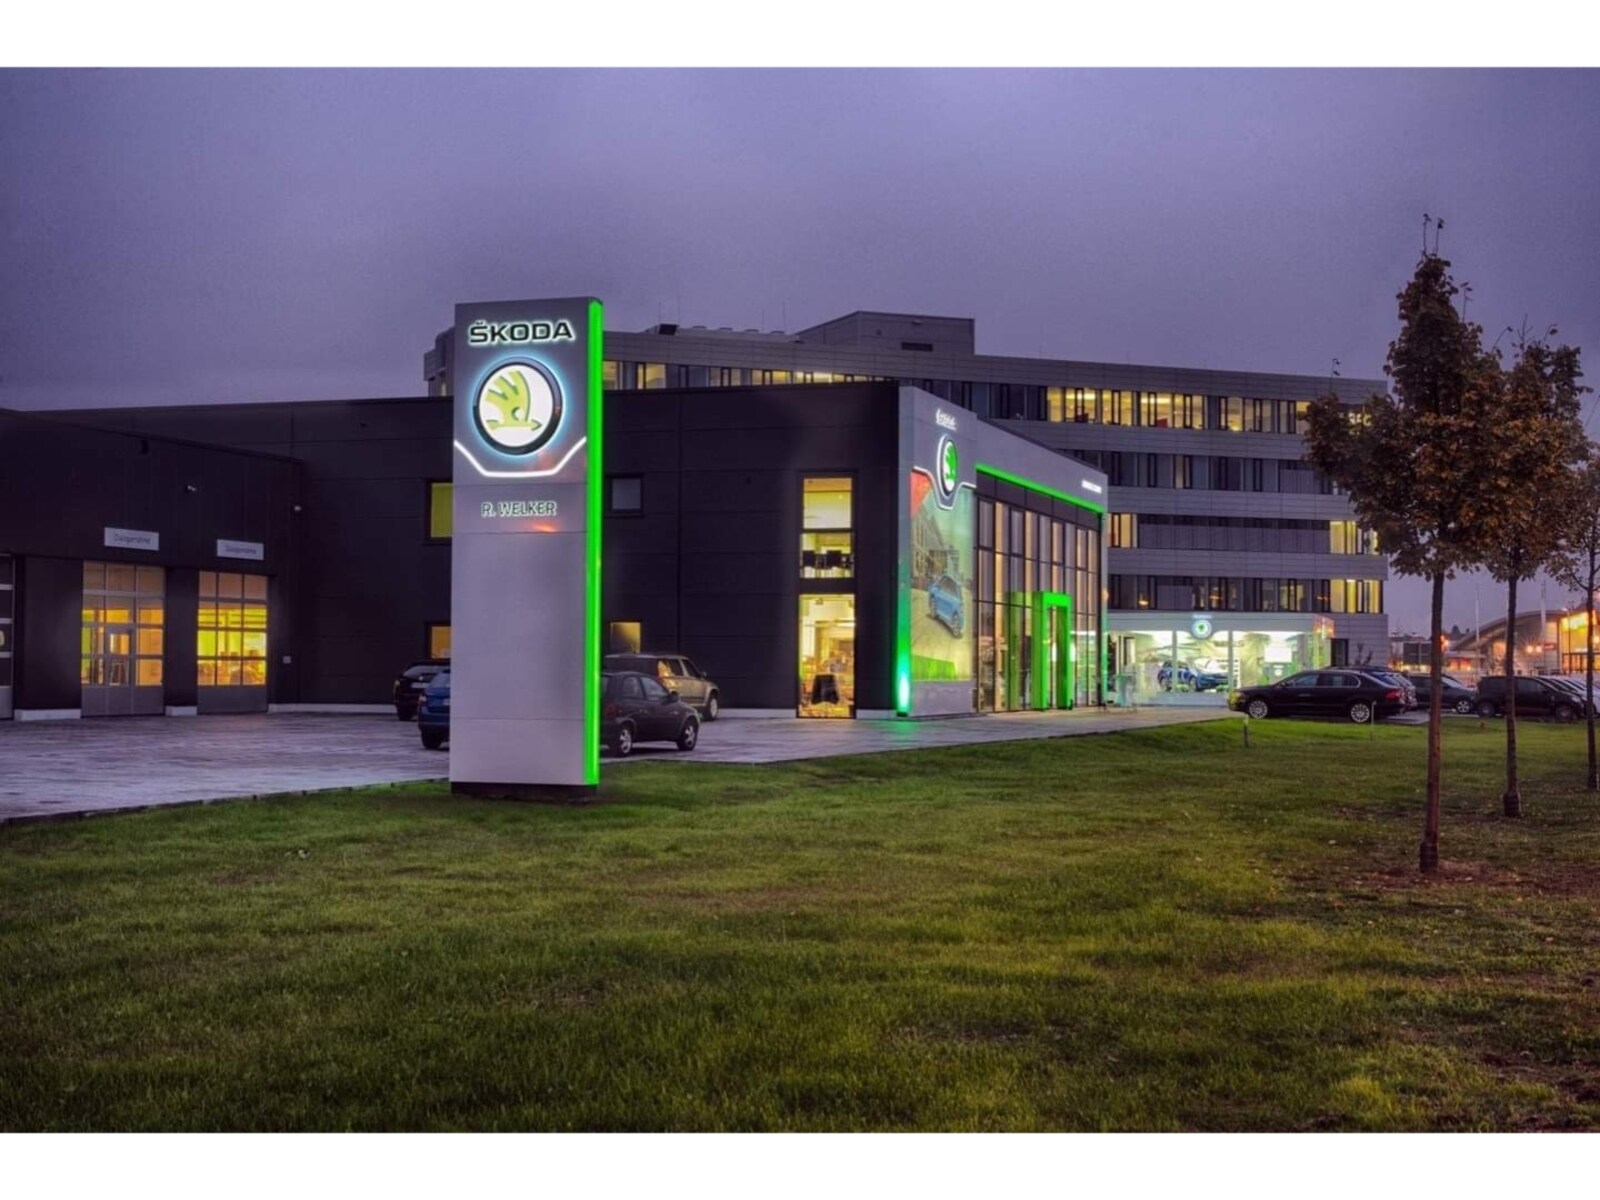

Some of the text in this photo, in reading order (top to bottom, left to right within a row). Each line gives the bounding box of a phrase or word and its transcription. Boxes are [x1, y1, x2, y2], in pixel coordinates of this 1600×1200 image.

[468, 319, 576, 345] ŠKODA
[481, 499, 558, 518] R. WELKER
